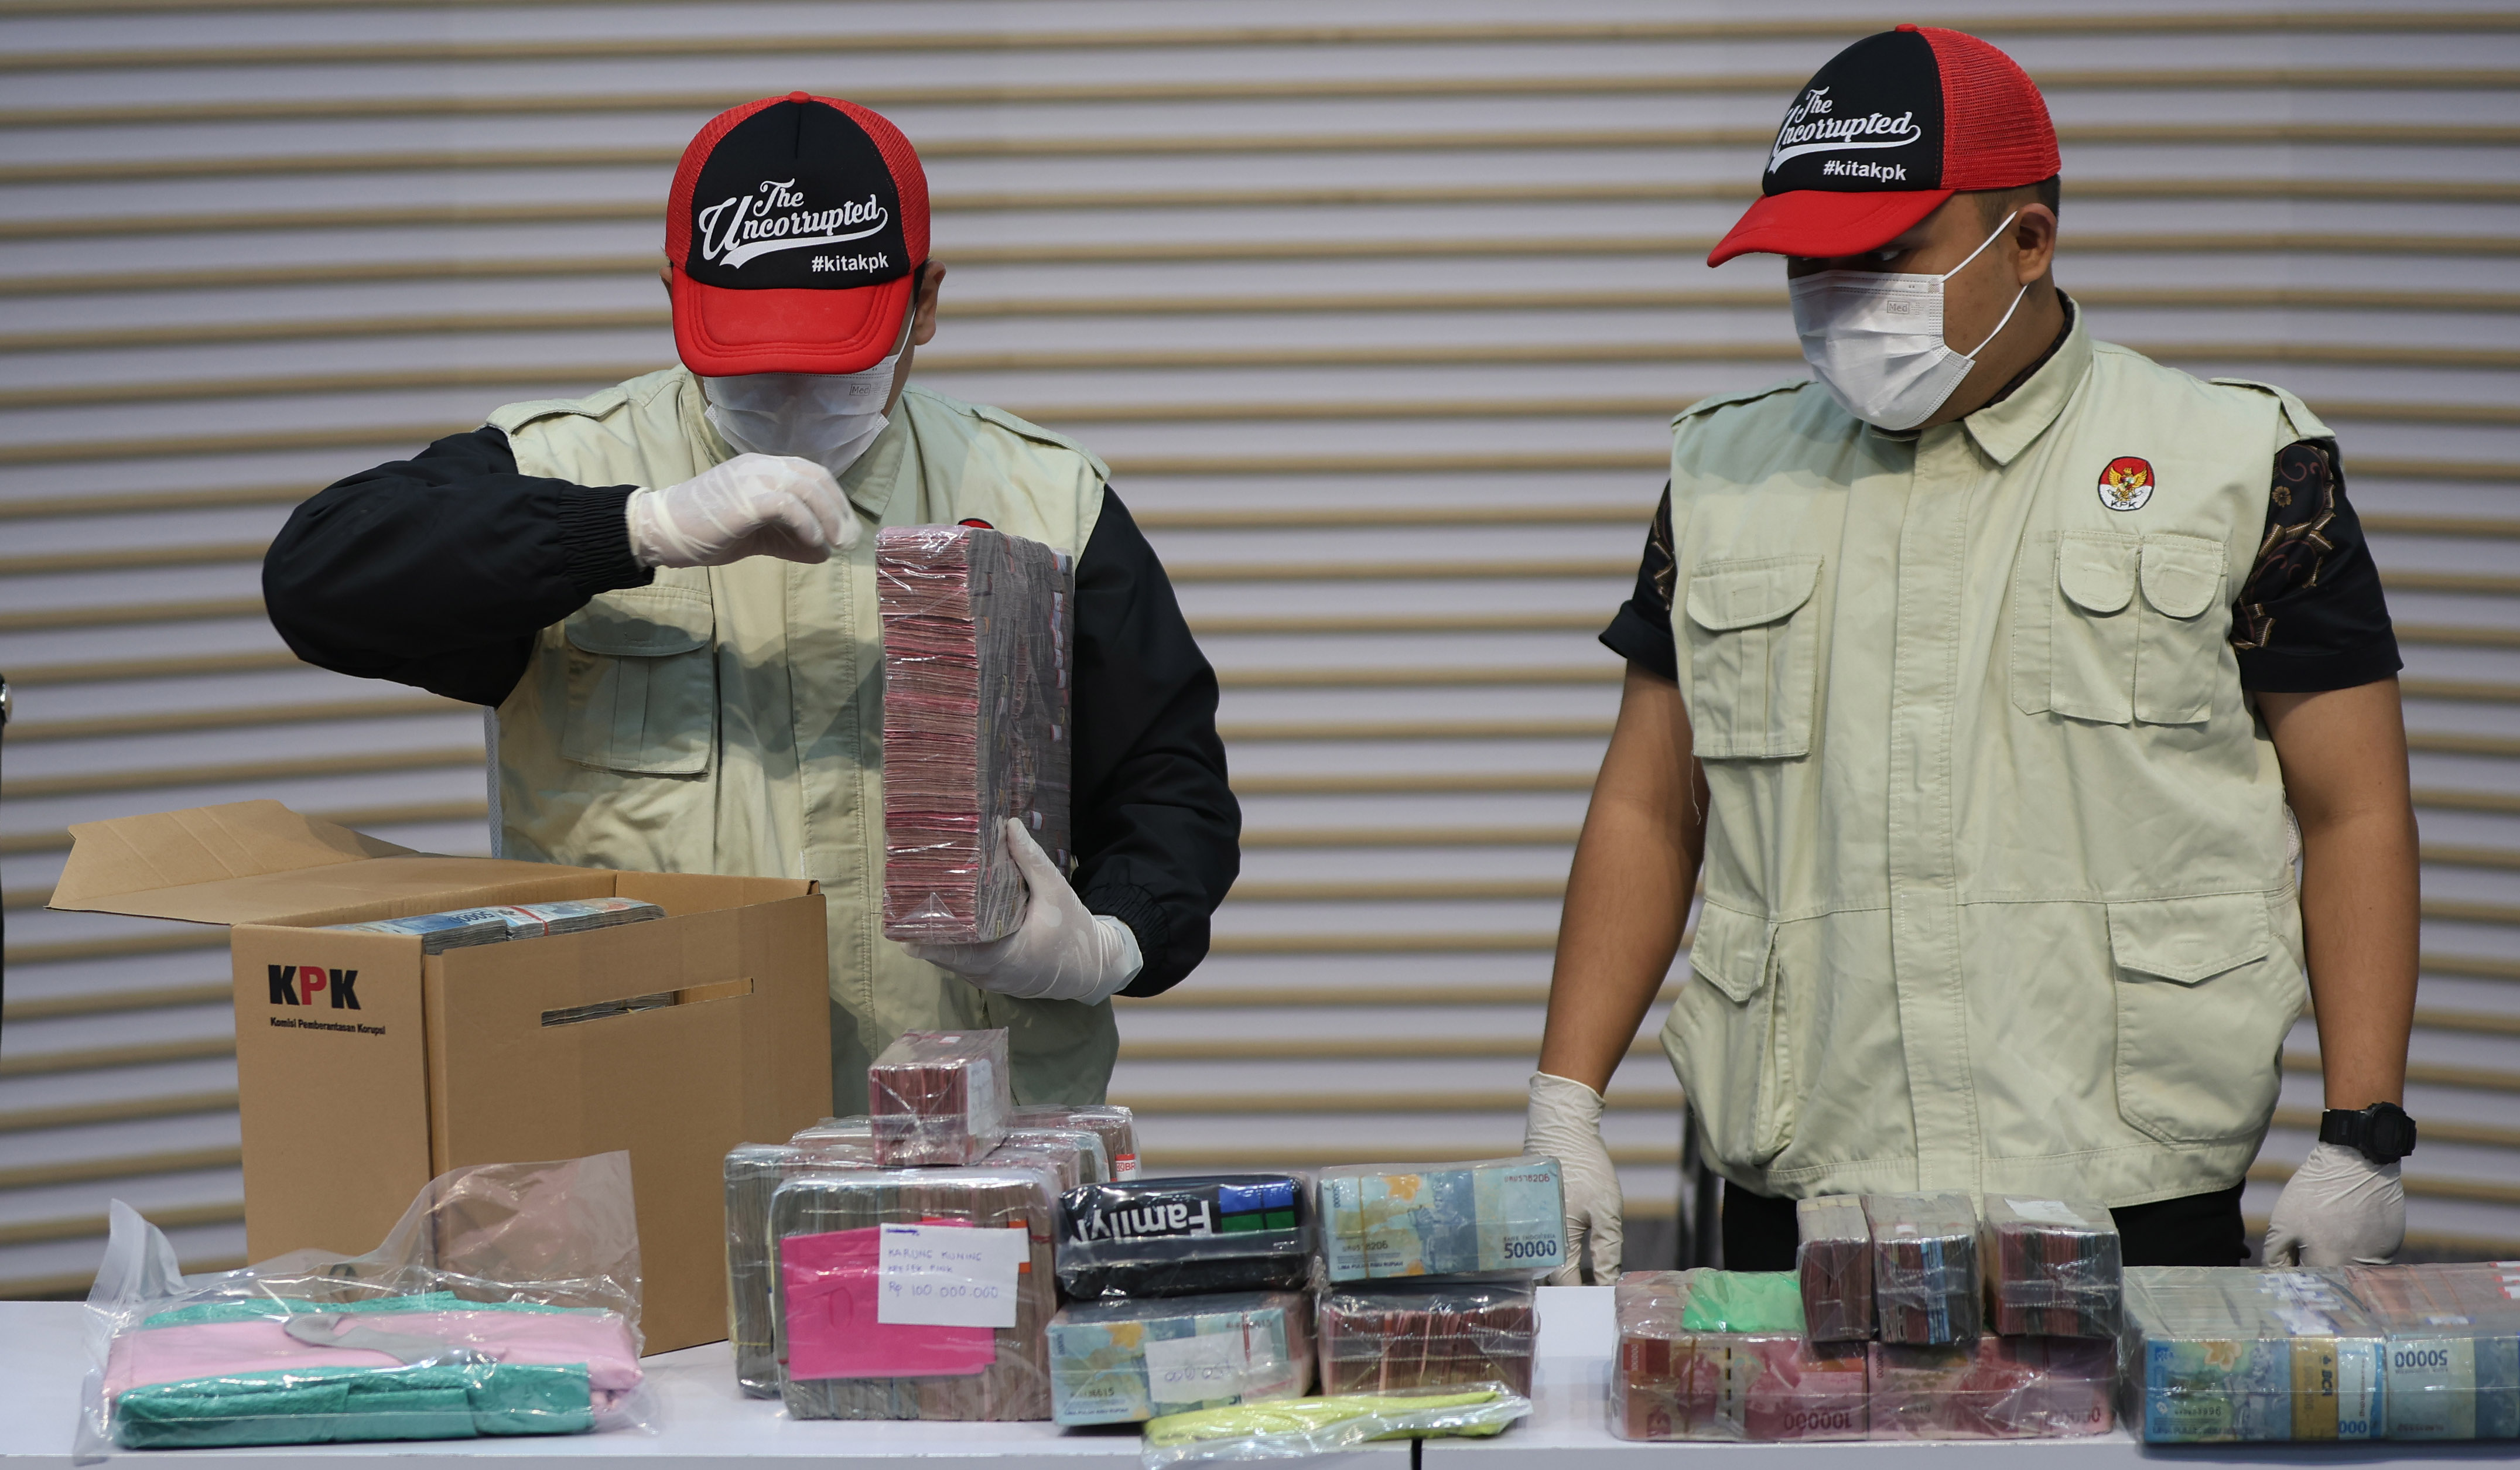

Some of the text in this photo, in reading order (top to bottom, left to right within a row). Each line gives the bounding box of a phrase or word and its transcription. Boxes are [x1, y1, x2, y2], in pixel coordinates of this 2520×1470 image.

[1796, 86, 1833, 123] The
[1823, 160, 1907, 183] #kitakpk
[753, 178, 804, 217] The
[699, 194, 888, 261] Uncorrupted
[812, 252, 889, 274] #kitakpk
[1889, 303, 1908, 312] Med
[852, 386, 869, 394] Med
[448, 911, 495, 924] 50000
[268, 965, 361, 1010] KPK
[270, 1017, 385, 1036] Komisi Pemberantasan Korupsi
[1504, 1240, 1557, 1259] 50000
[2395, 1349, 2449, 1368] 50000
[1784, 1412, 1853, 1431] 100000
